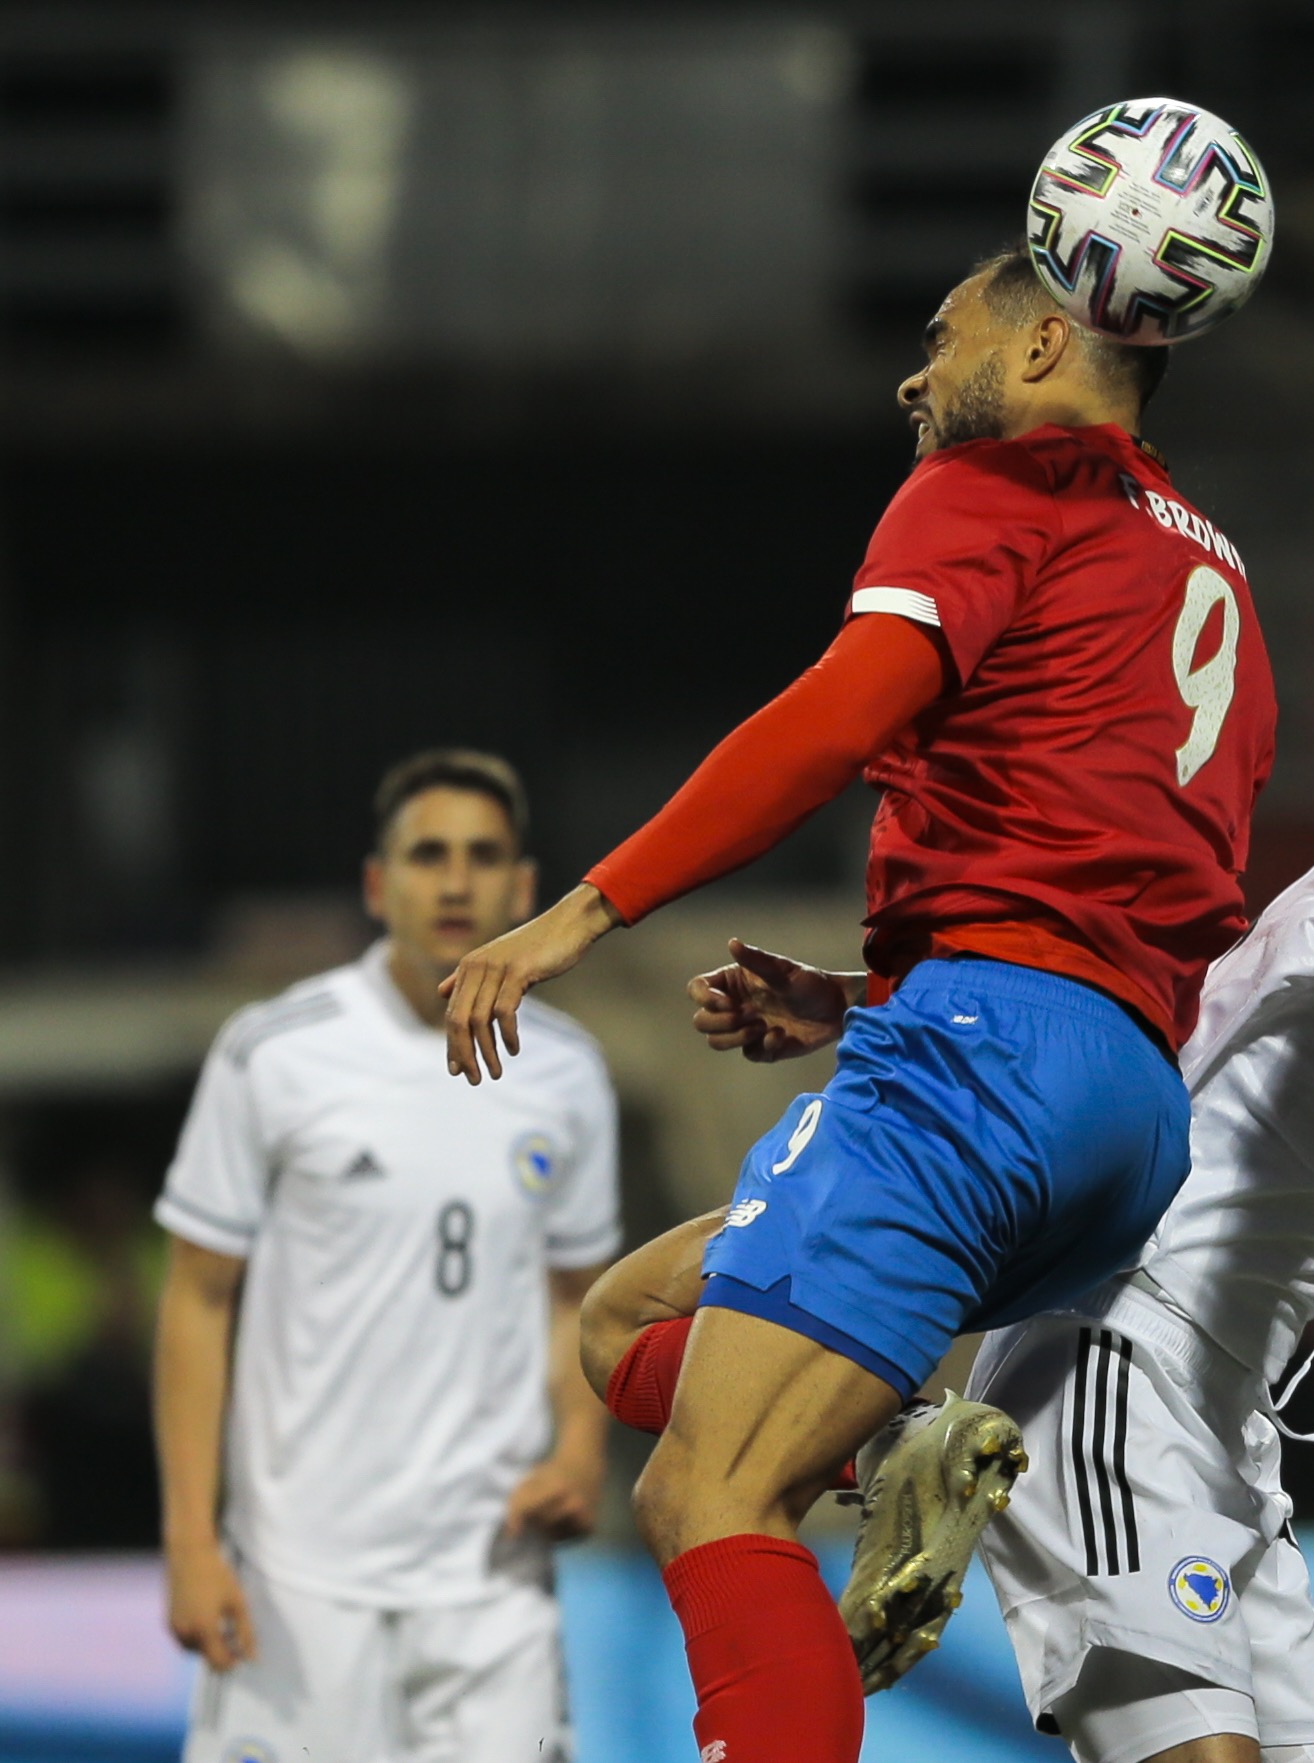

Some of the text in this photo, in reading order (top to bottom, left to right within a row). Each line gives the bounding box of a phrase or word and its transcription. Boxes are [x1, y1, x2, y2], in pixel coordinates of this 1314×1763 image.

[1173, 565, 1239, 787] 9
[772, 1099, 822, 1175] 9
[435, 1200, 475, 1299] 8
